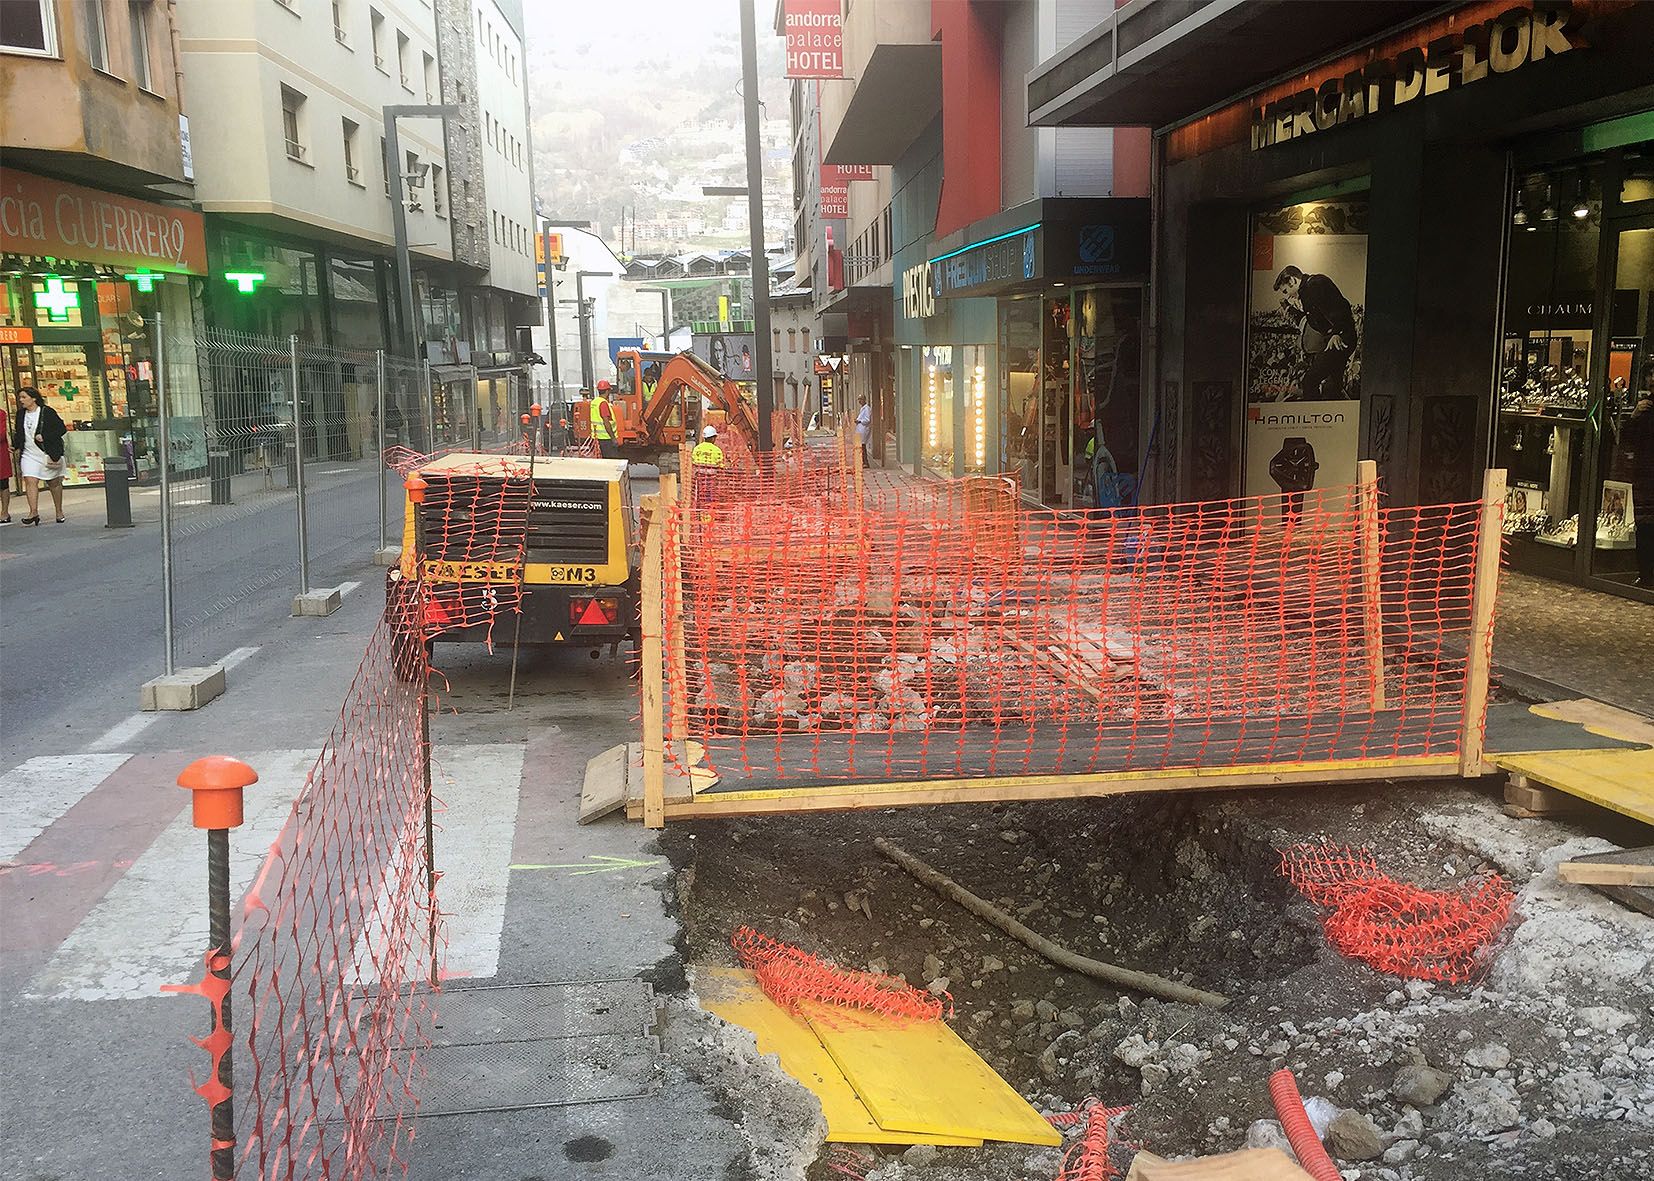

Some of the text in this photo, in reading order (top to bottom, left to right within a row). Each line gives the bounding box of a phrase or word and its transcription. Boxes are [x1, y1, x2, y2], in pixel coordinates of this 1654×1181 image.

[785, 11, 841, 27] andorra
[785, 31, 842, 49] palace
[787, 52, 842, 70] HOTEL
[1394, 37, 1455, 106] DE
[837, 165, 872, 174] HOTEL
[820, 186, 848, 194] andorra
[820, 196, 848, 204] palace
[820, 204, 848, 214] HOTEL
[1254, 413, 1345, 425] HAMILTON
[566, 567, 597, 582] M3
